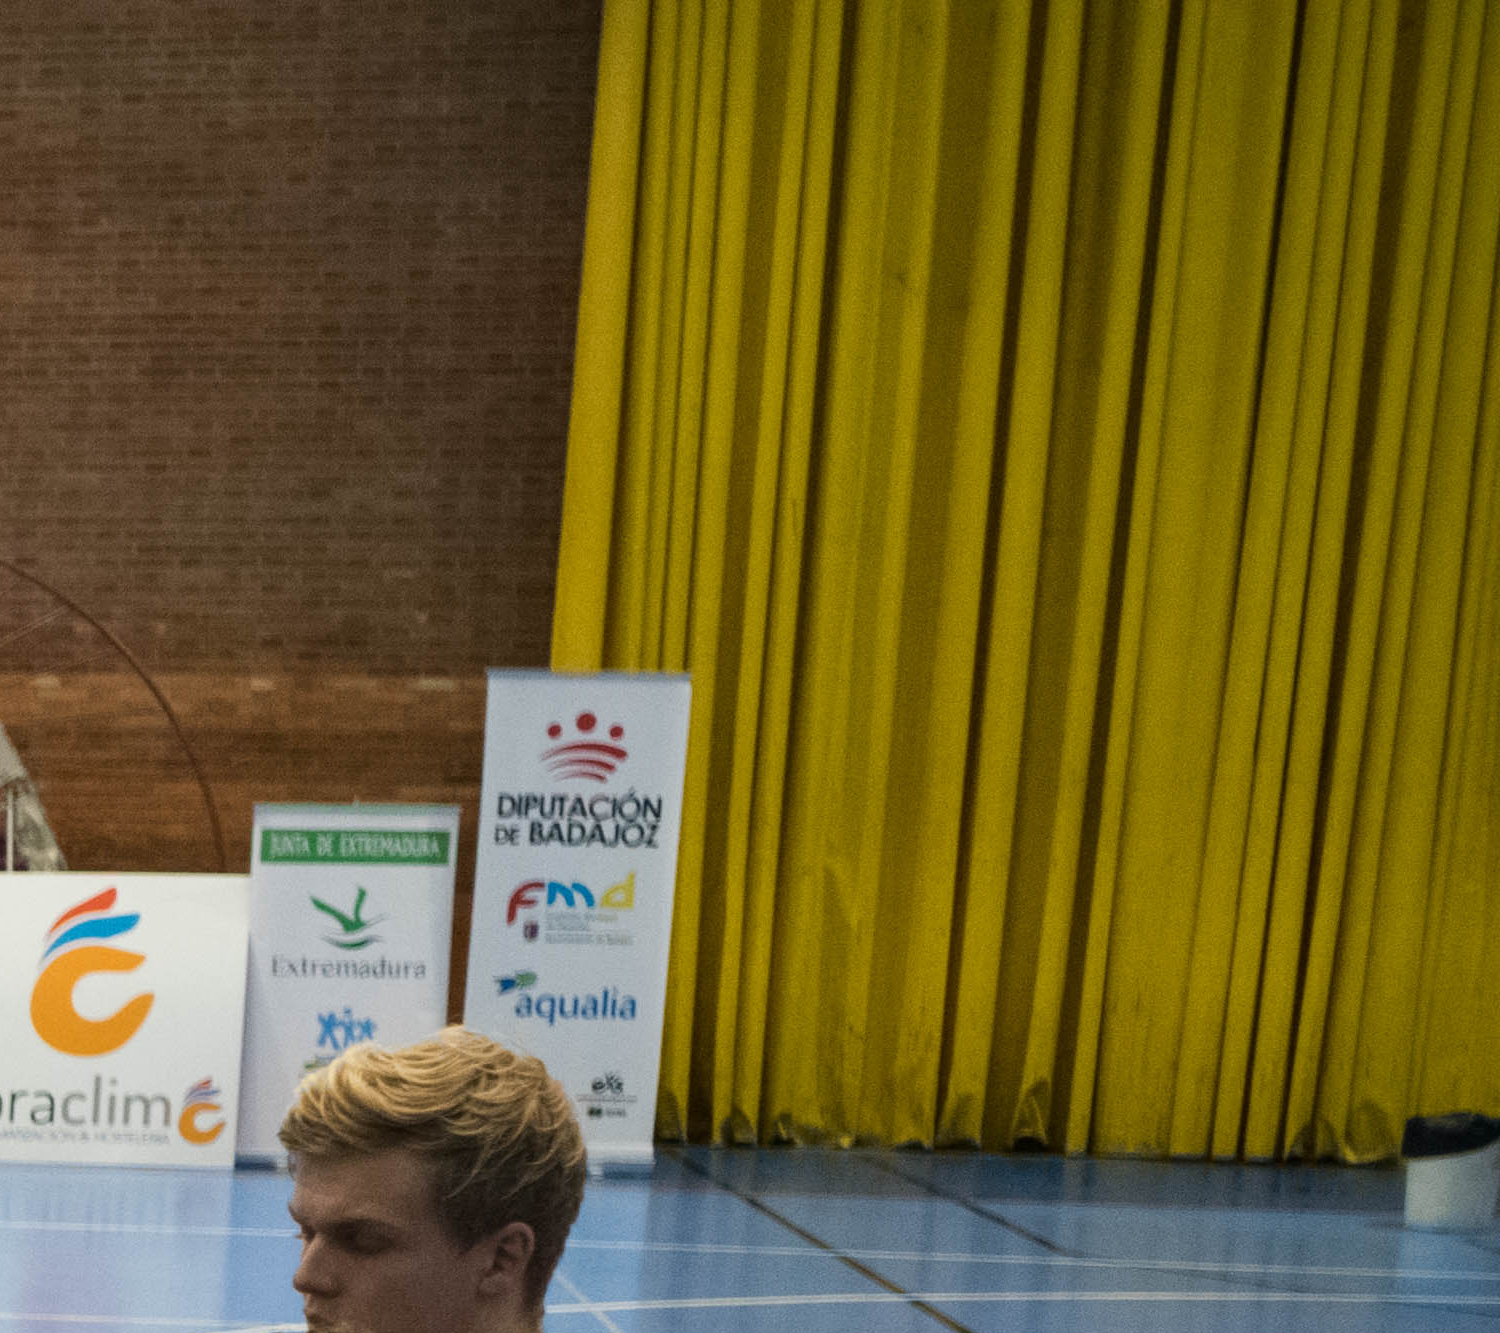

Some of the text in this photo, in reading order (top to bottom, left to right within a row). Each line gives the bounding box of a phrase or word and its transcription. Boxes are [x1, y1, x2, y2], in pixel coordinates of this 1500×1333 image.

[497, 787, 663, 821] DIPUTACIÓN
[270, 833, 441, 860] JUNTA DE EXTREMADURA
[495, 820, 661, 850] DE BADAJOZ
[270, 953, 428, 981] Extremadura
[514, 988, 638, 1027] aqualia
